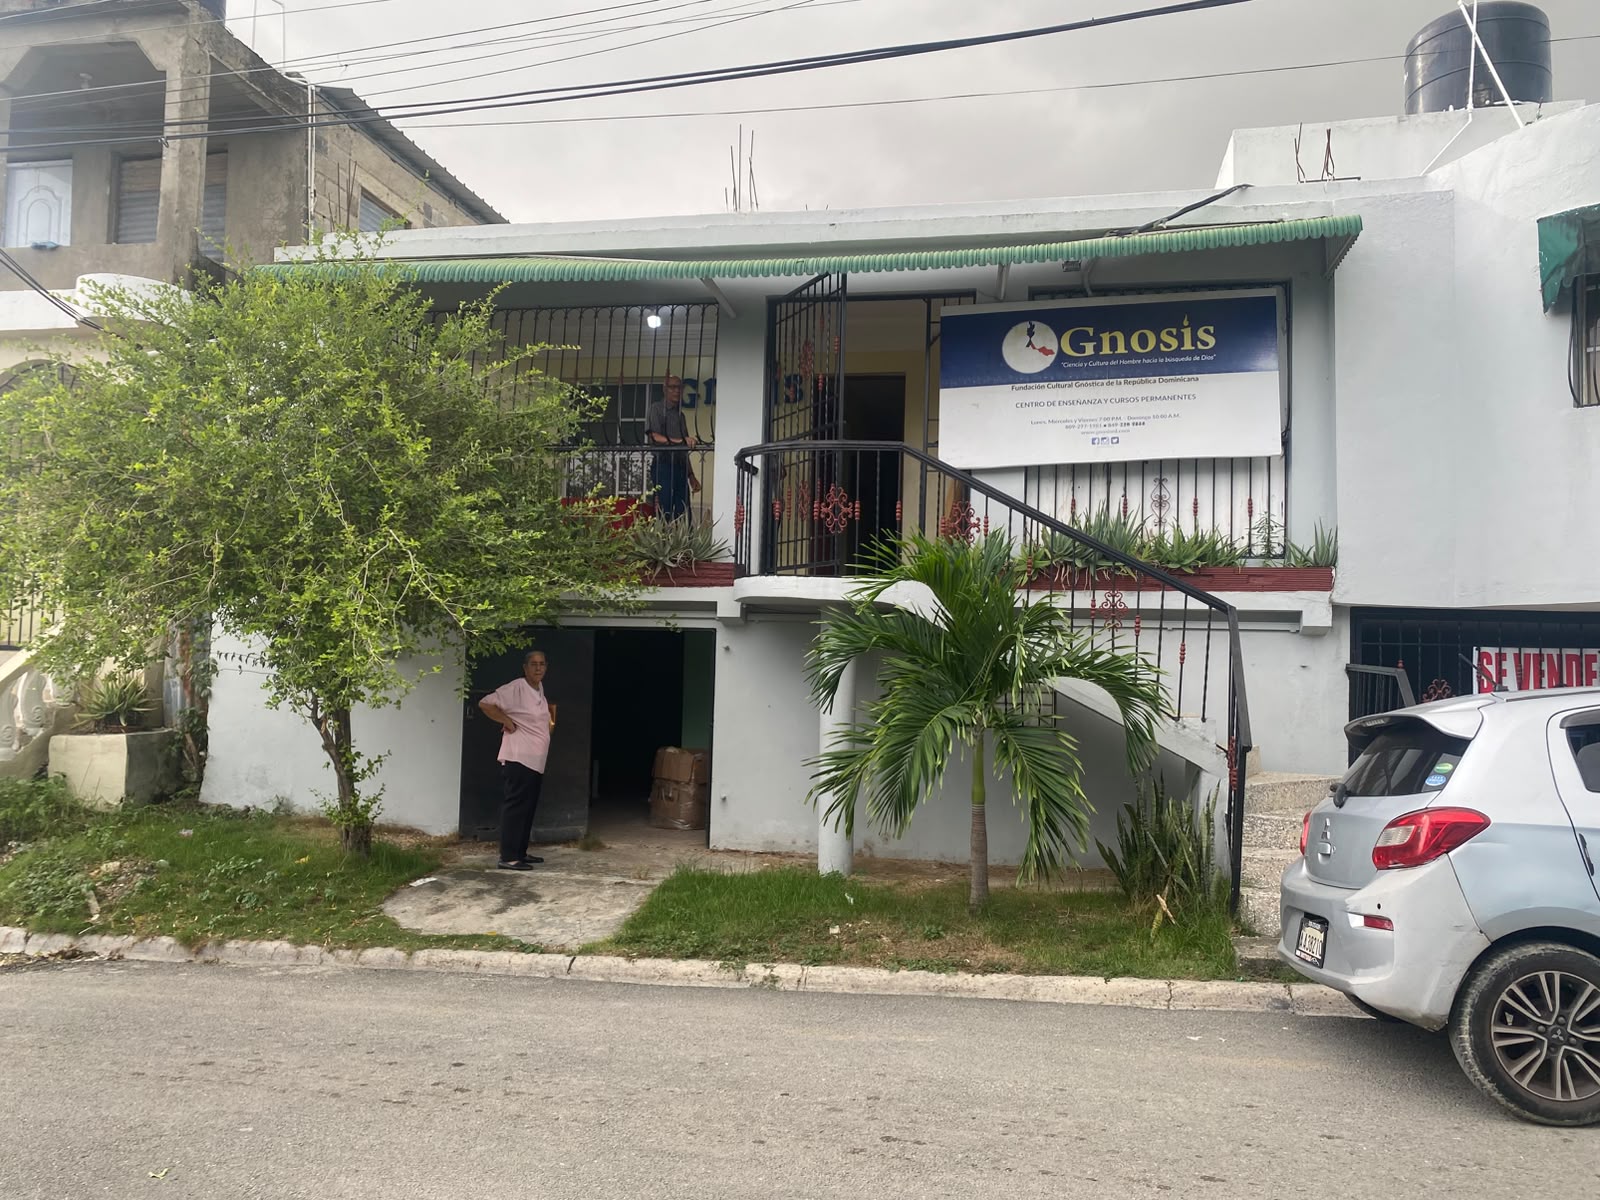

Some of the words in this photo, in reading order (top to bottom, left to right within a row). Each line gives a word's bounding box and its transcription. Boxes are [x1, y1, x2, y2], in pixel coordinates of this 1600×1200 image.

[1060, 314, 1216, 357] Gnosis
[1011, 383, 1045, 391] Fundación
[1046, 382, 1073, 390] Cultural
[1123, 377, 1157, 386] República
[1158, 376, 1199, 384] Dominicana
[1058, 398, 1102, 407] ENSEÑANZA
[1109, 396, 1139, 404] CURSOS
[1140, 393, 1197, 402] PERMANENTES
